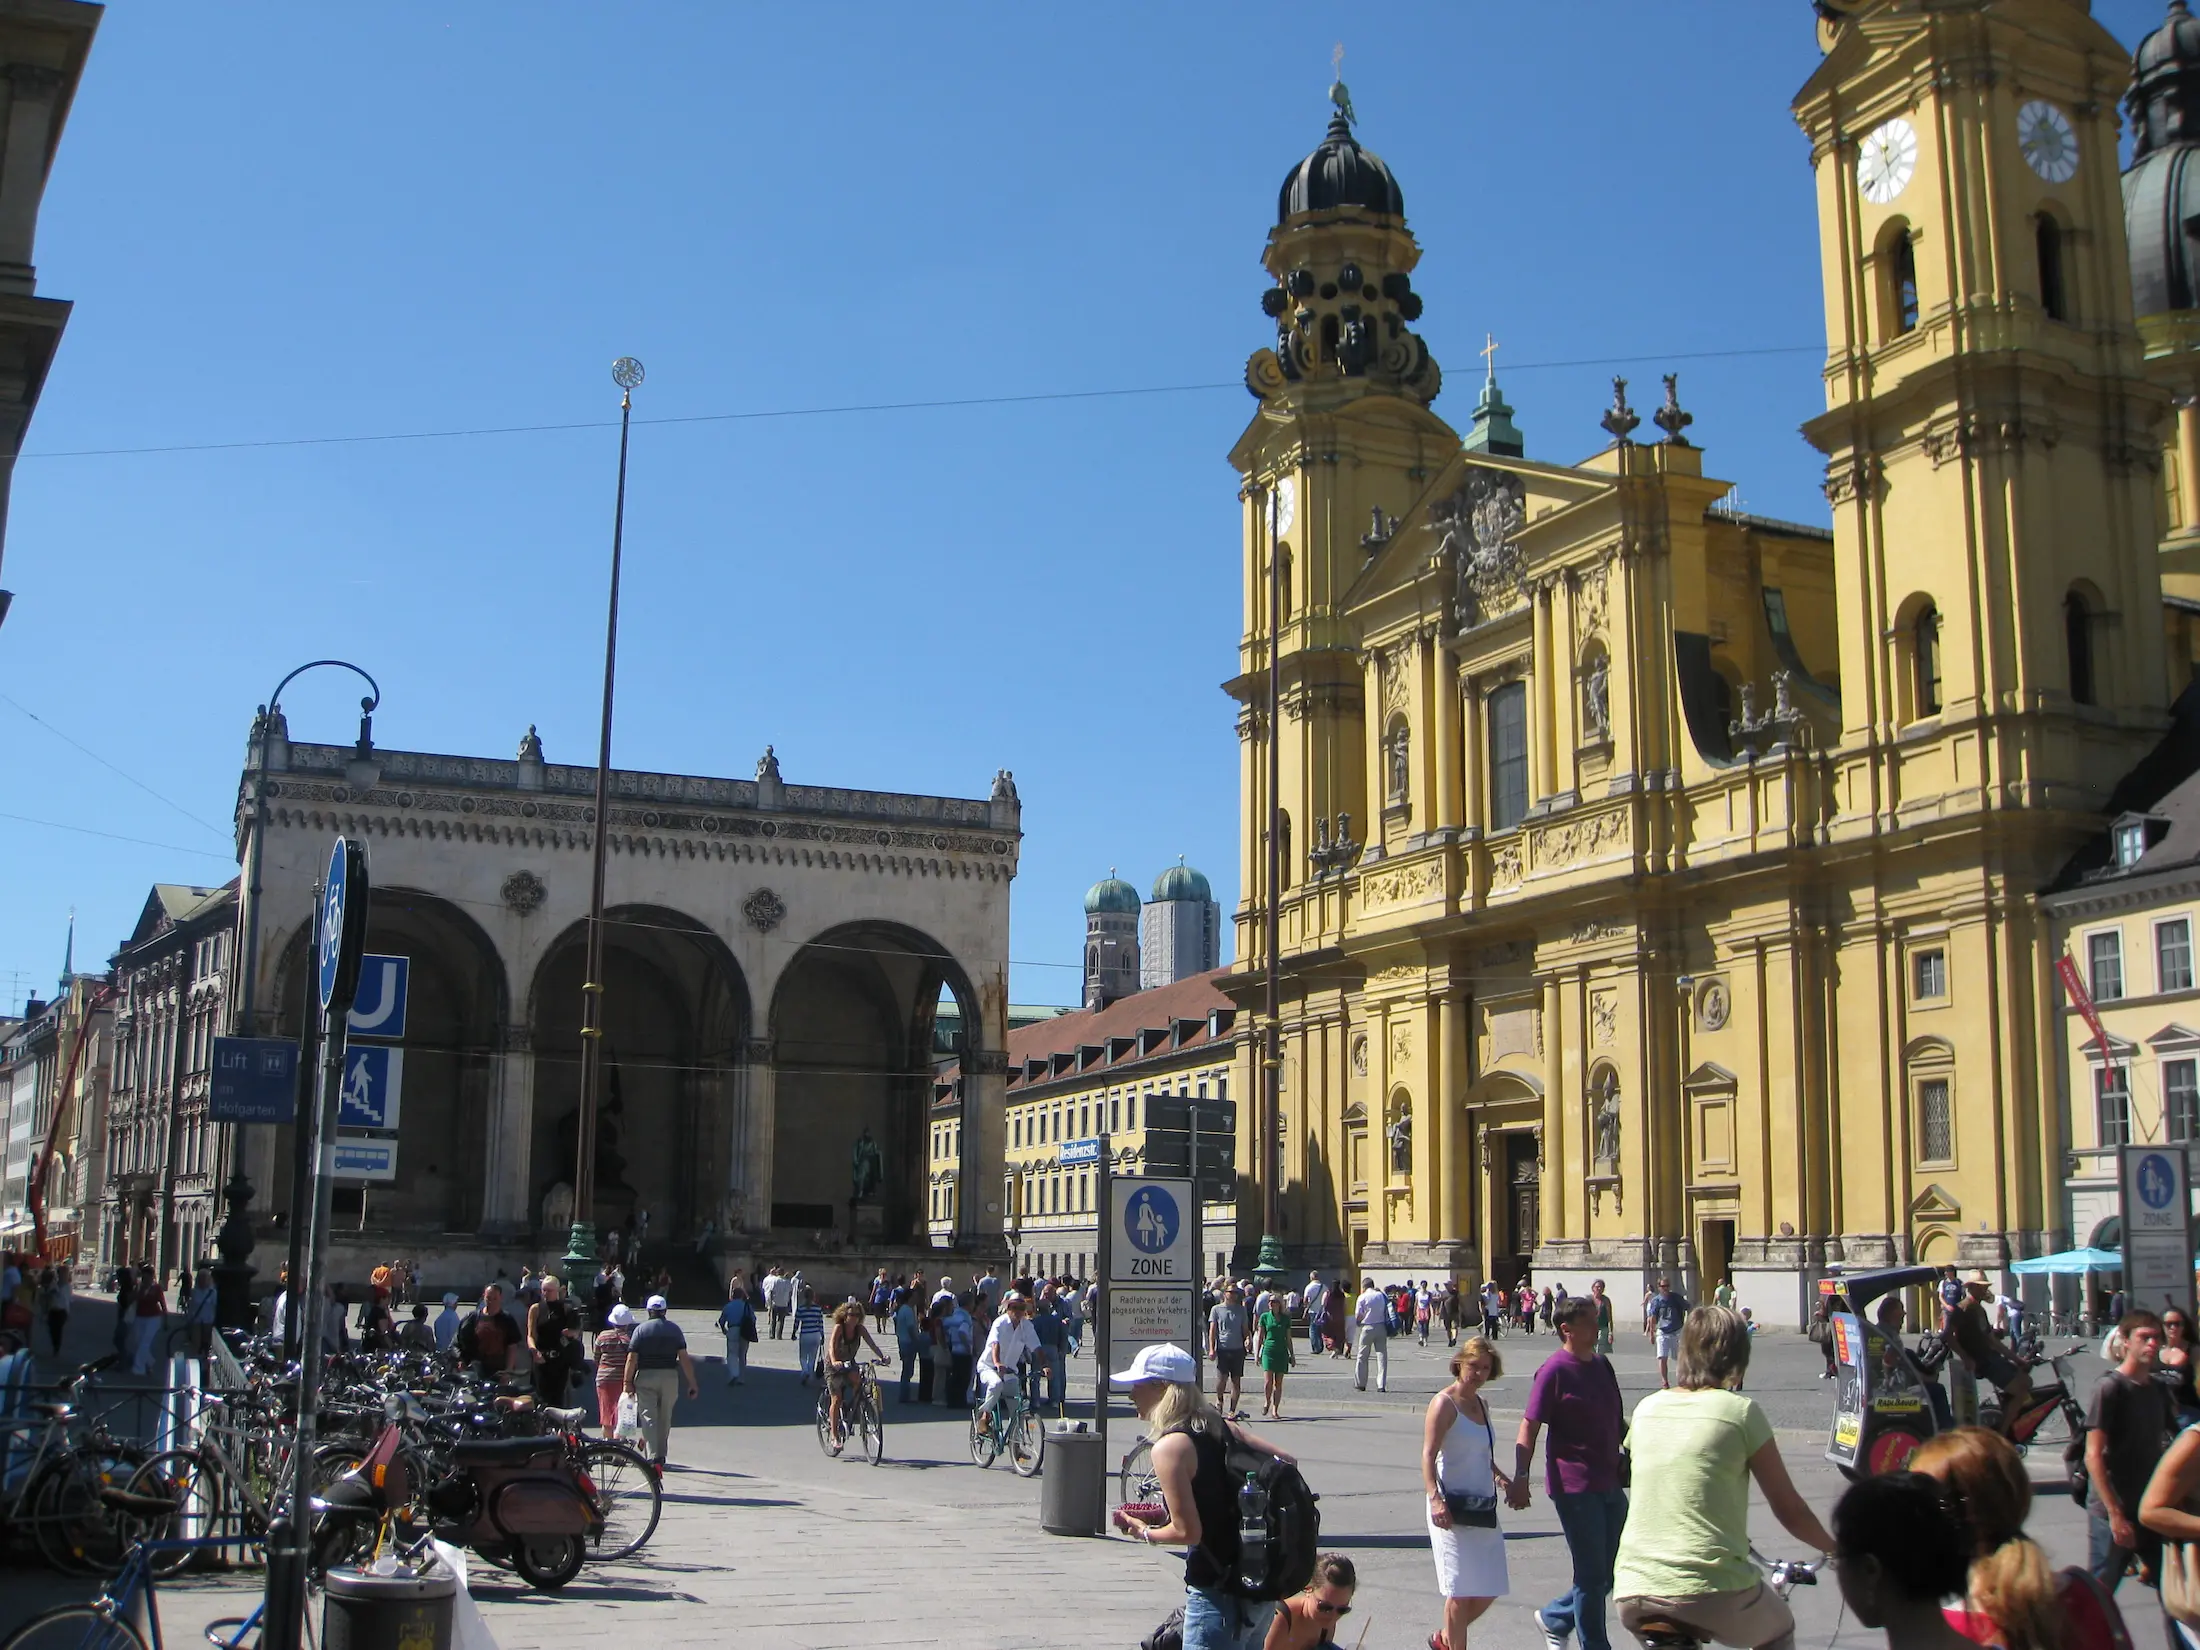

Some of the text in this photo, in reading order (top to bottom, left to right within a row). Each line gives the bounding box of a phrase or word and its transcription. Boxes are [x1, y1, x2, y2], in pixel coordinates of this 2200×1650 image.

[221, 1051, 247, 1069] Lift
[218, 1101, 276, 1118] Hofgarten
[1060, 1142, 1098, 1160] Residenzstr.
[2143, 1212, 2173, 1226] ZONE
[1131, 1258, 1173, 1275] ZONE
[1120, 1295, 1183, 1304] Radfahren auf der
[1111, 1305, 1191, 1316] abgesenkten Verkehrs-
[1134, 1316, 1169, 1325] fläche frei
